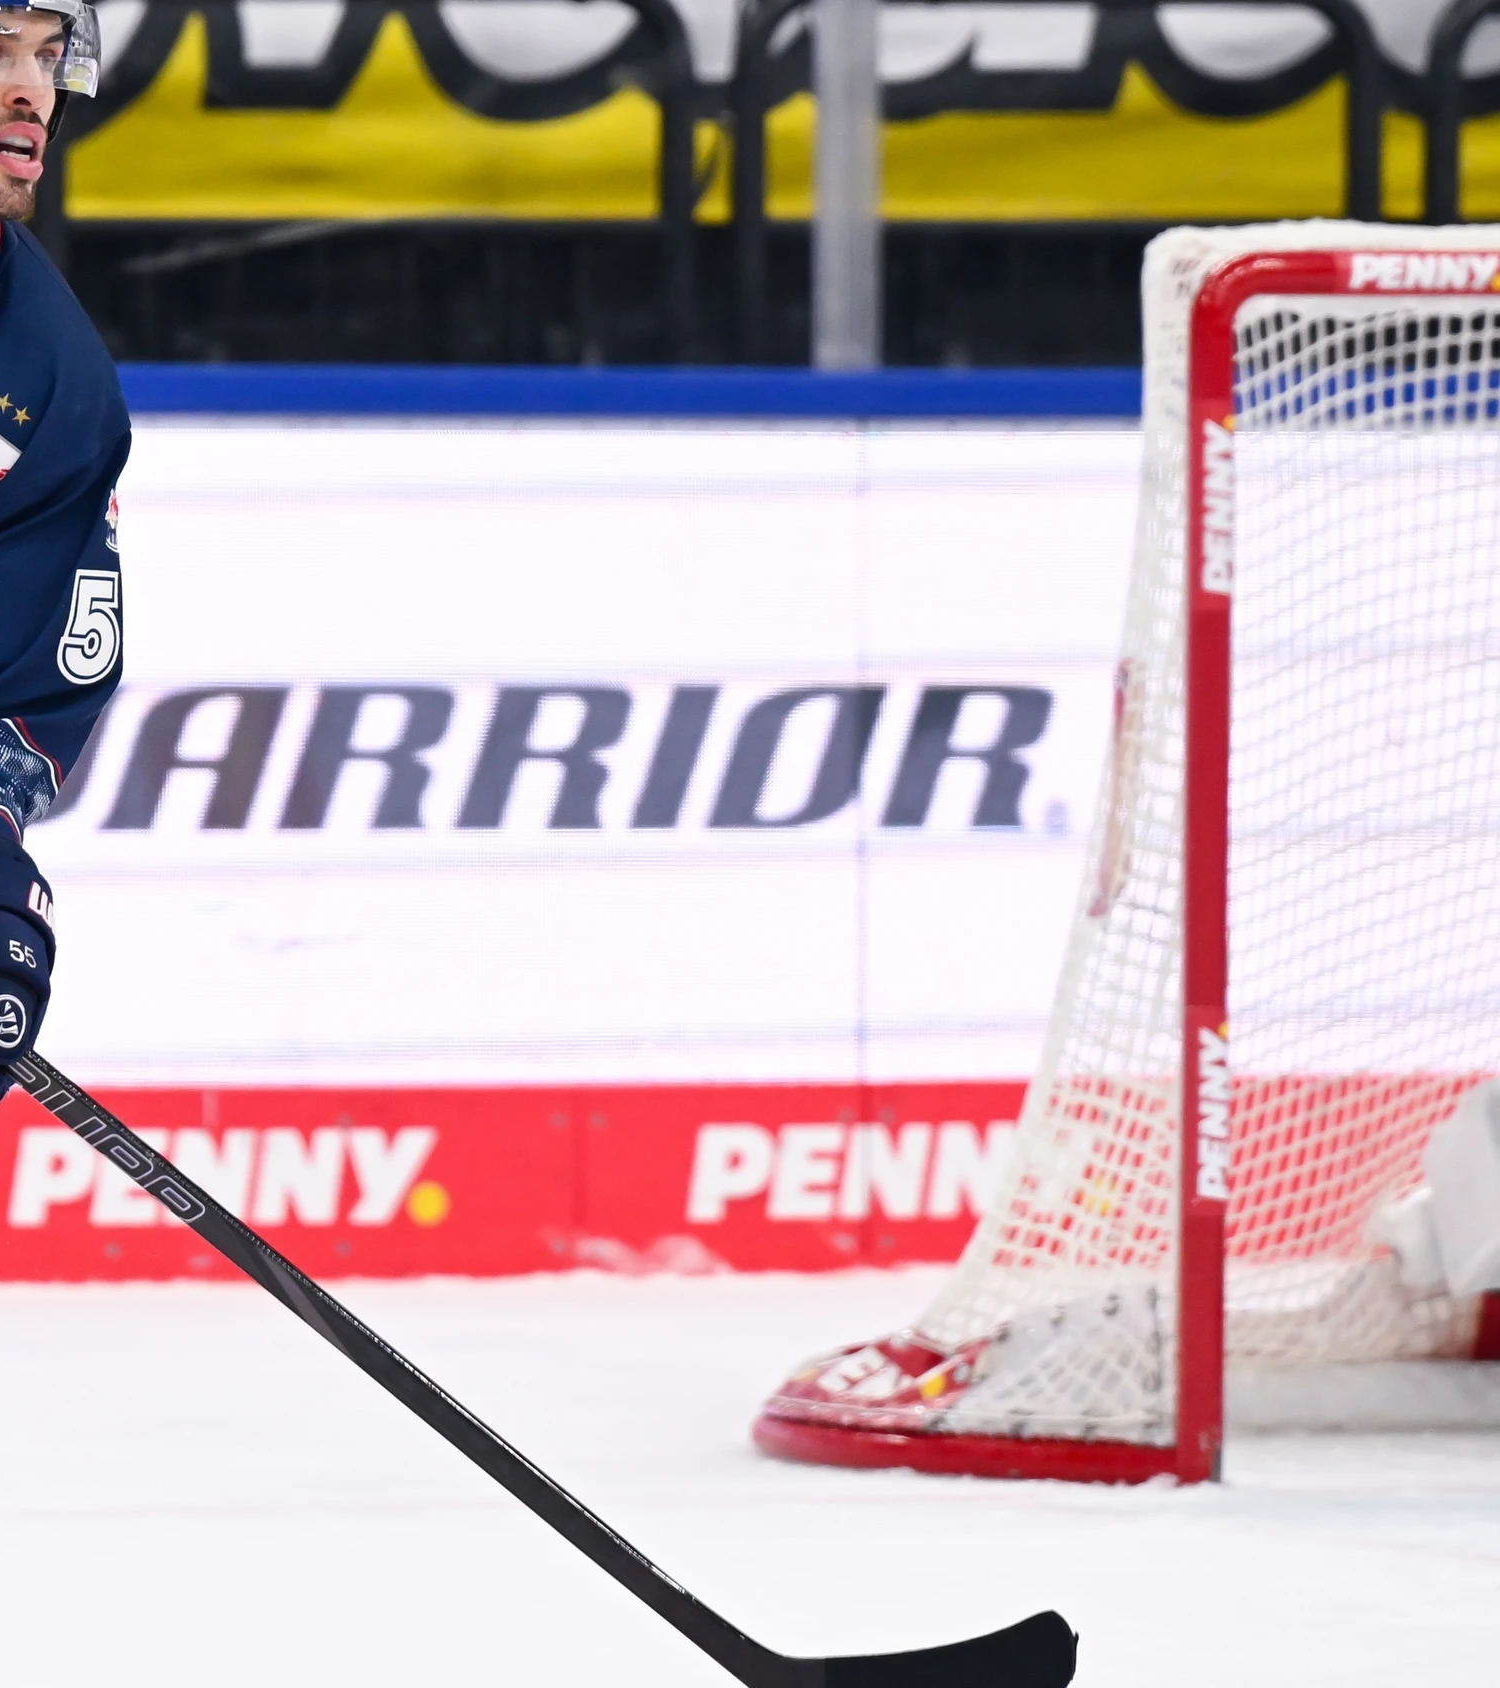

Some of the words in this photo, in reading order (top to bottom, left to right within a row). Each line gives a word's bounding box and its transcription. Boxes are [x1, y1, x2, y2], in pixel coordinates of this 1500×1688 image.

[57, 568, 122, 685] 5
[8, 938, 37, 969] 55
[686, 1121, 1012, 1223] PENN
